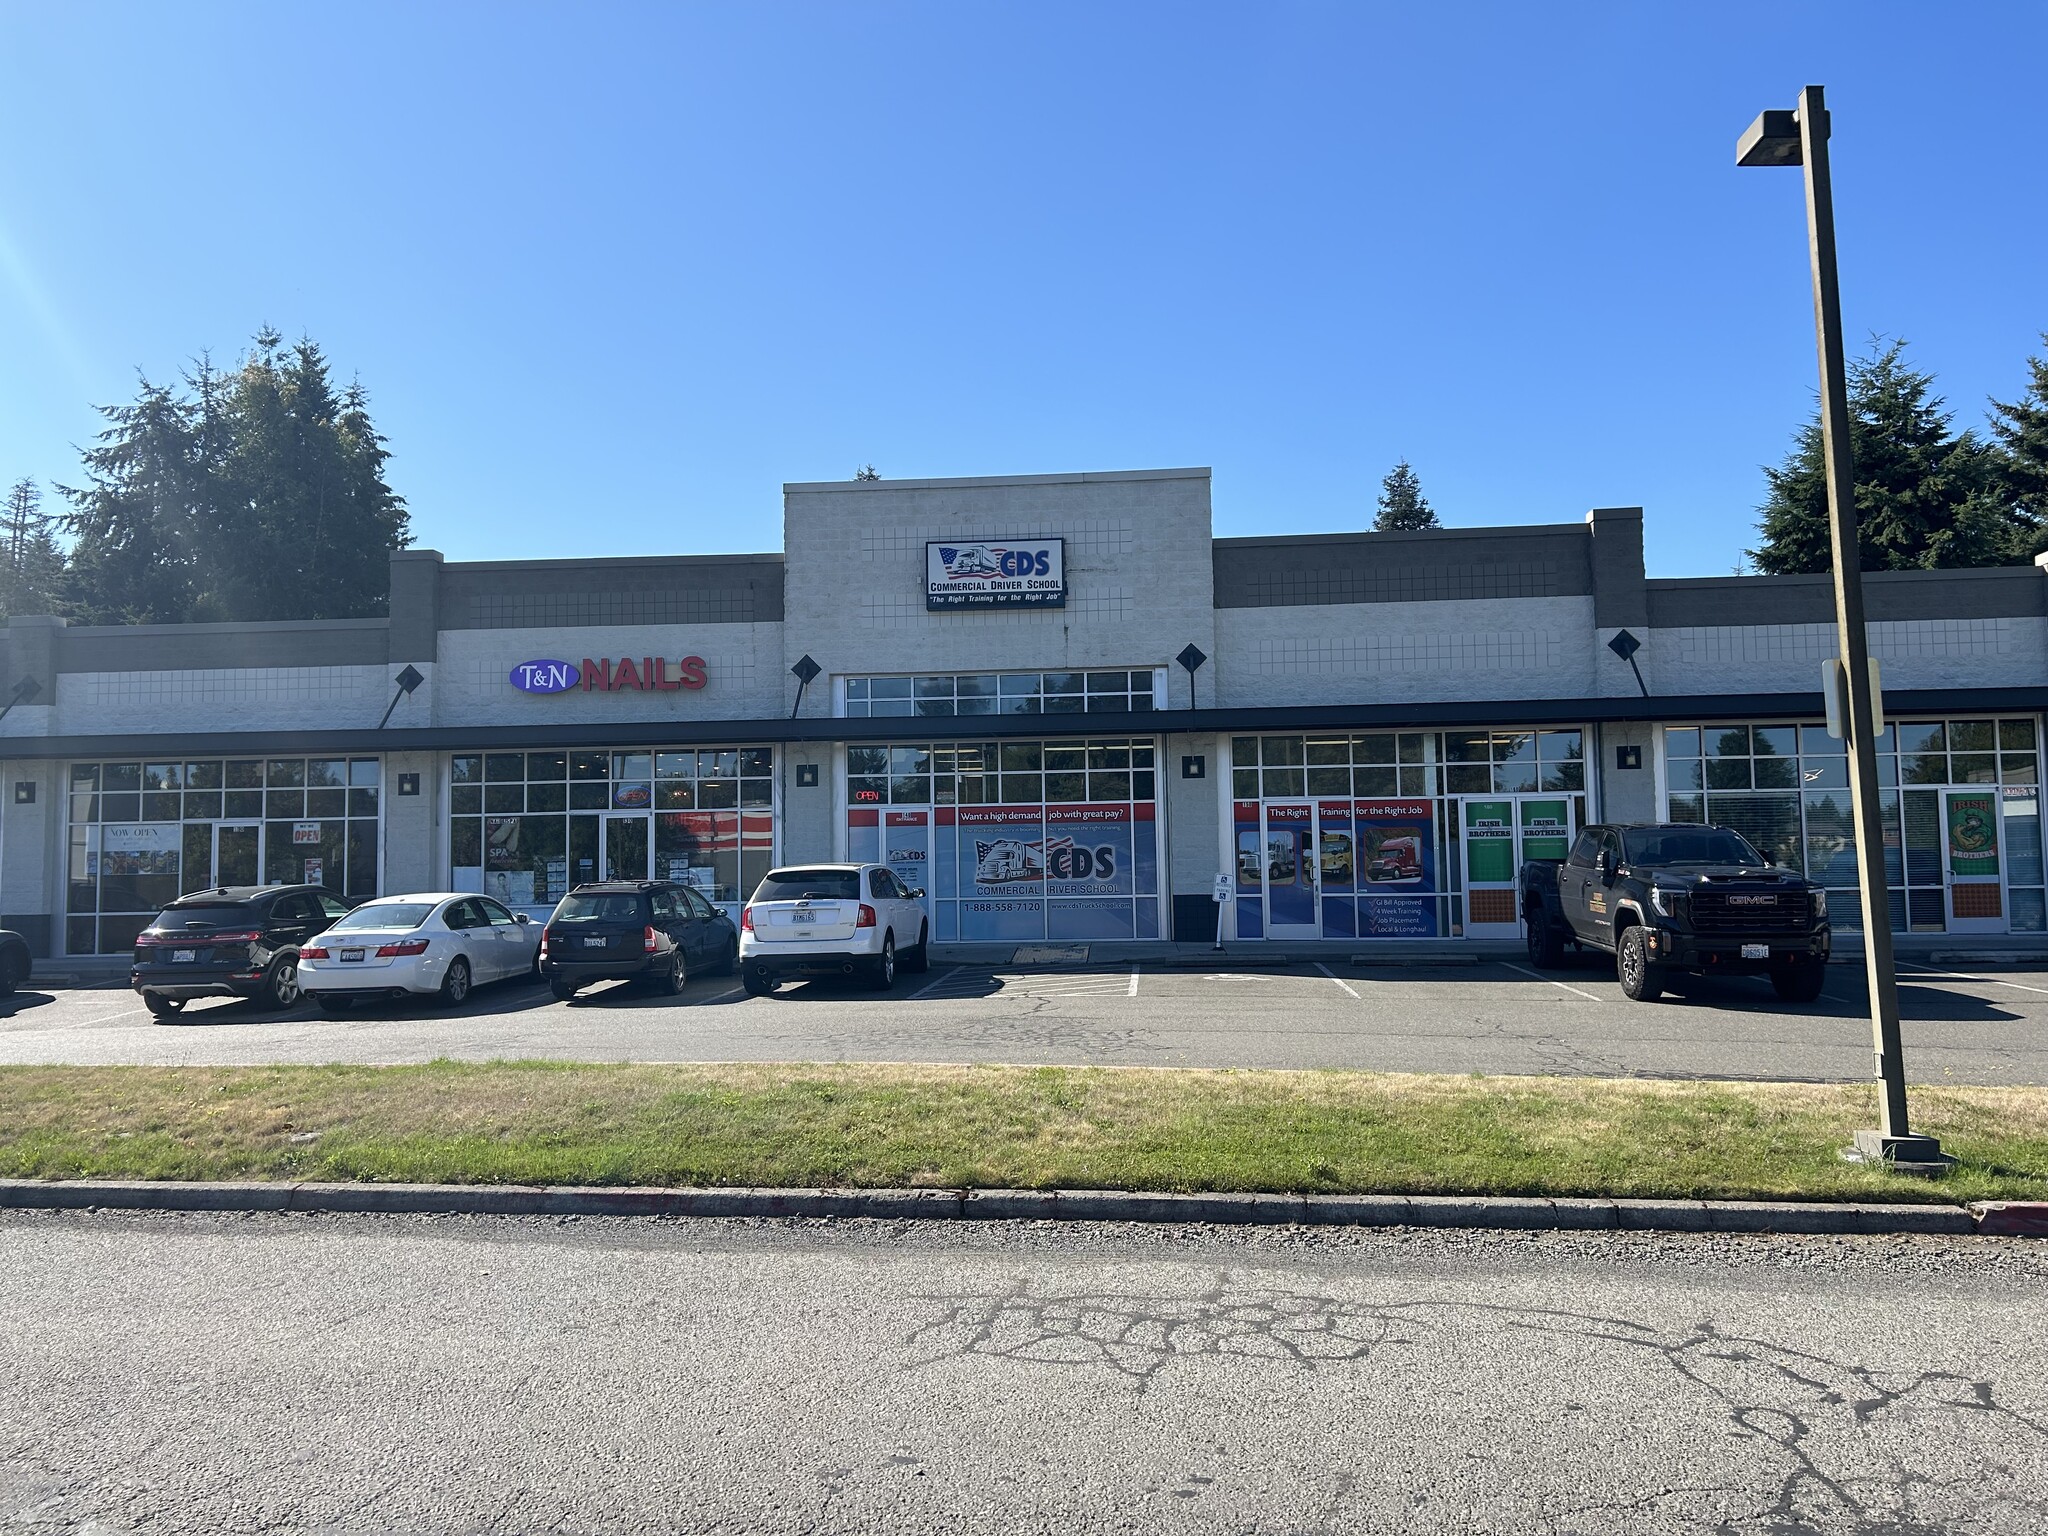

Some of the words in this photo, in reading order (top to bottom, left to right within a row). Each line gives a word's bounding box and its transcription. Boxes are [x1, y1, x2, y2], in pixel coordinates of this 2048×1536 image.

[1000, 550, 1050, 577] CDS
[930, 582, 986, 592] COMMERCIAL
[991, 581, 1022, 590] DRIVER
[1027, 580, 1060, 589] SCHOOL
[969, 595, 993, 603] Training
[519, 665, 568, 688] T&N
[582, 656, 708, 692] NAILS
[856, 791, 879, 800] OPEN
[1952, 800, 1989, 814] IRISH
[960, 812, 982, 820] Want
[990, 811, 1007, 823] high
[1008, 811, 1041, 819] demand
[1049, 810, 1062, 820] job
[1063, 809, 1081, 818] with
[1082, 810, 1103, 820] great
[1105, 809, 1124, 819] pay?
[1270, 808, 1286, 817] The
[1286, 808, 1309, 819] Right
[1319, 807, 1350, 818] Training
[1356, 806, 1368, 815] for
[1370, 806, 1384, 815] the
[1385, 806, 1407, 816] Right
[1408, 806, 1423, 814] Job
[111, 828, 129, 836] NOW
[134, 828, 158, 836] OPEN
[294, 830, 320, 841] OPEN
[1524, 829, 1567, 837] BROTHERS
[489, 848, 508, 857] SPA
[909, 851, 926, 860] CDS
[1952, 849, 1995, 859] BROTHERS
[1051, 847, 1115, 879] CDS
[977, 886, 1040, 895] COMMERCIAL
[1046, 885, 1077, 894] RIVER
[1080, 884, 1120, 893] SCHOOL
[1393, 899, 1422, 907] Approved
[1729, 895, 1775, 905] GMC
[964, 903, 1040, 912] 1-888-558-7120
